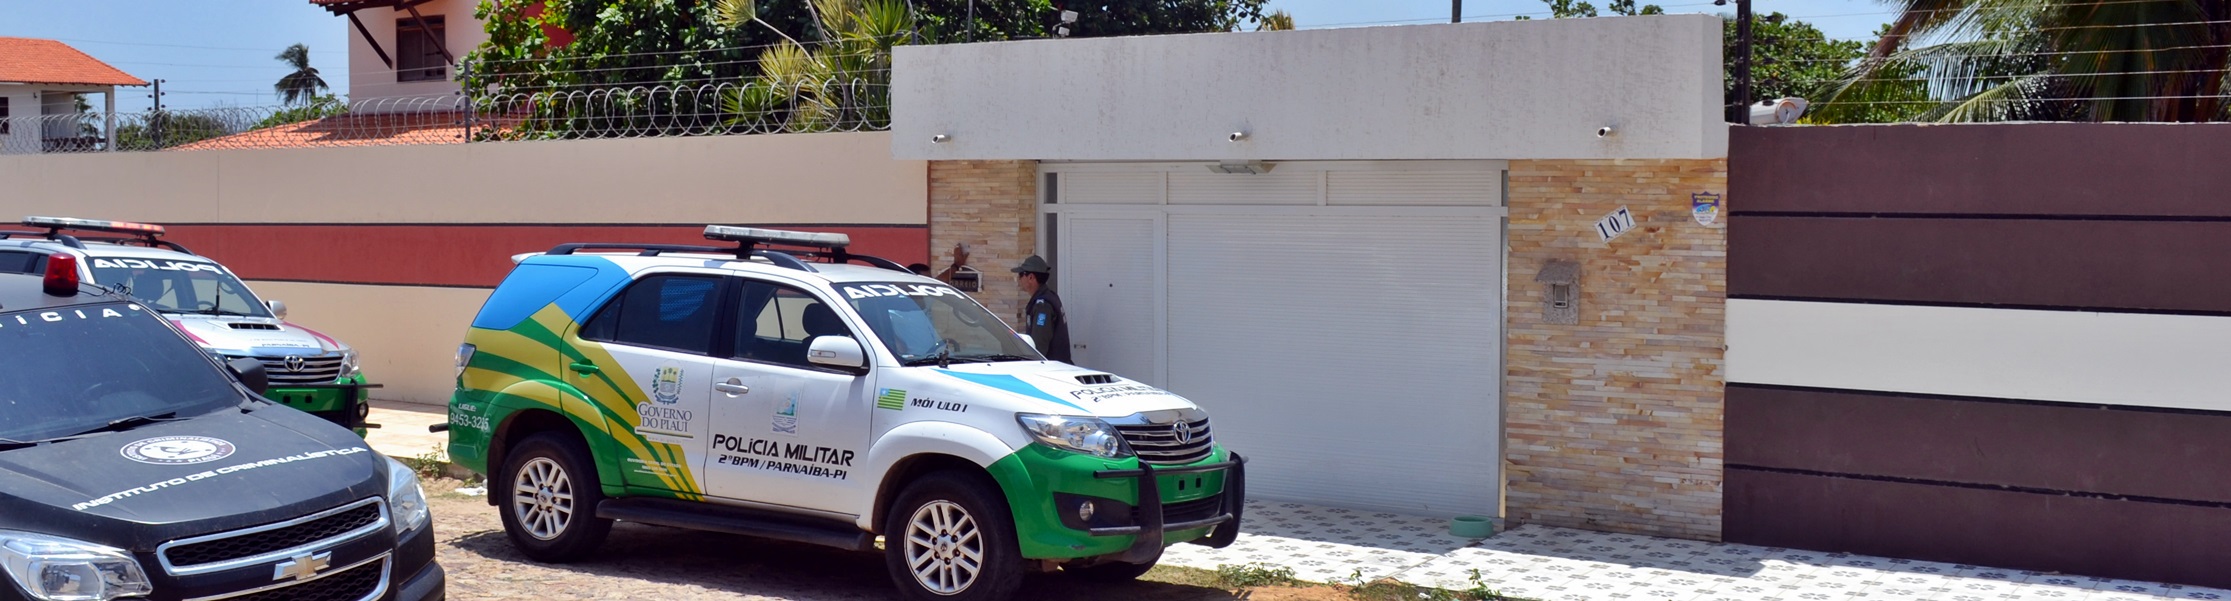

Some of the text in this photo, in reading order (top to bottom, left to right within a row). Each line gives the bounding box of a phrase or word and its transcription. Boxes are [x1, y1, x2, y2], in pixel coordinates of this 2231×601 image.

[1598, 209, 1630, 238] 107
[638, 403, 692, 421] GOVERNO
[642, 417, 658, 429] DO
[784, 443, 855, 467] MILITAR
[72, 446, 368, 511] INSTITUTO DE CRIMINALÍSTICA
[766, 460, 847, 480] PARNAÍBA-PI
